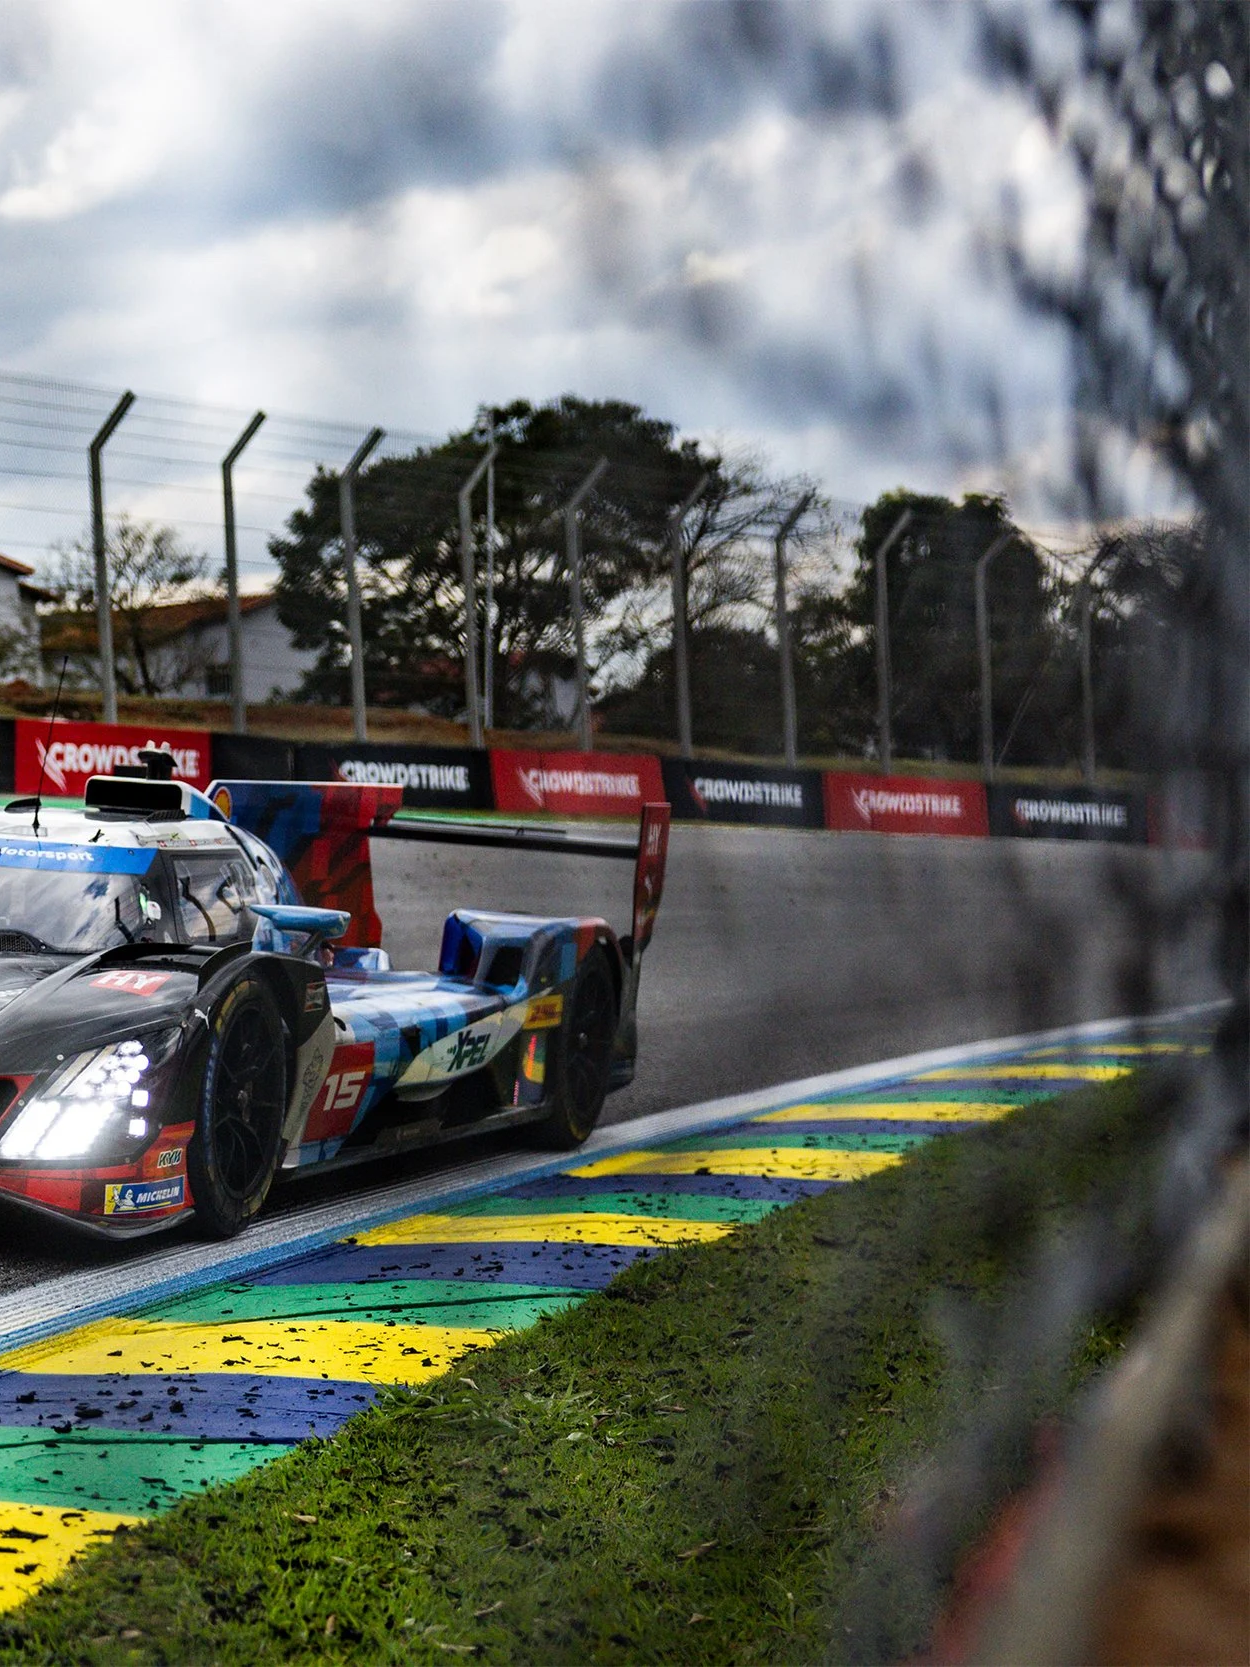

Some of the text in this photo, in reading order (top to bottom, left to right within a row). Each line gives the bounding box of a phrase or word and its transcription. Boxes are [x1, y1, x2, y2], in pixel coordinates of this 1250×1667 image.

[49, 742, 199, 777] CROWDSKE
[339, 760, 471, 791] CROWDSTRIKE
[694, 777, 802, 808] CROWDSTRIKE
[97, 971, 166, 990] HY
[323, 1071, 365, 1111] 15
[136, 1186, 181, 1203] MICHELIN
